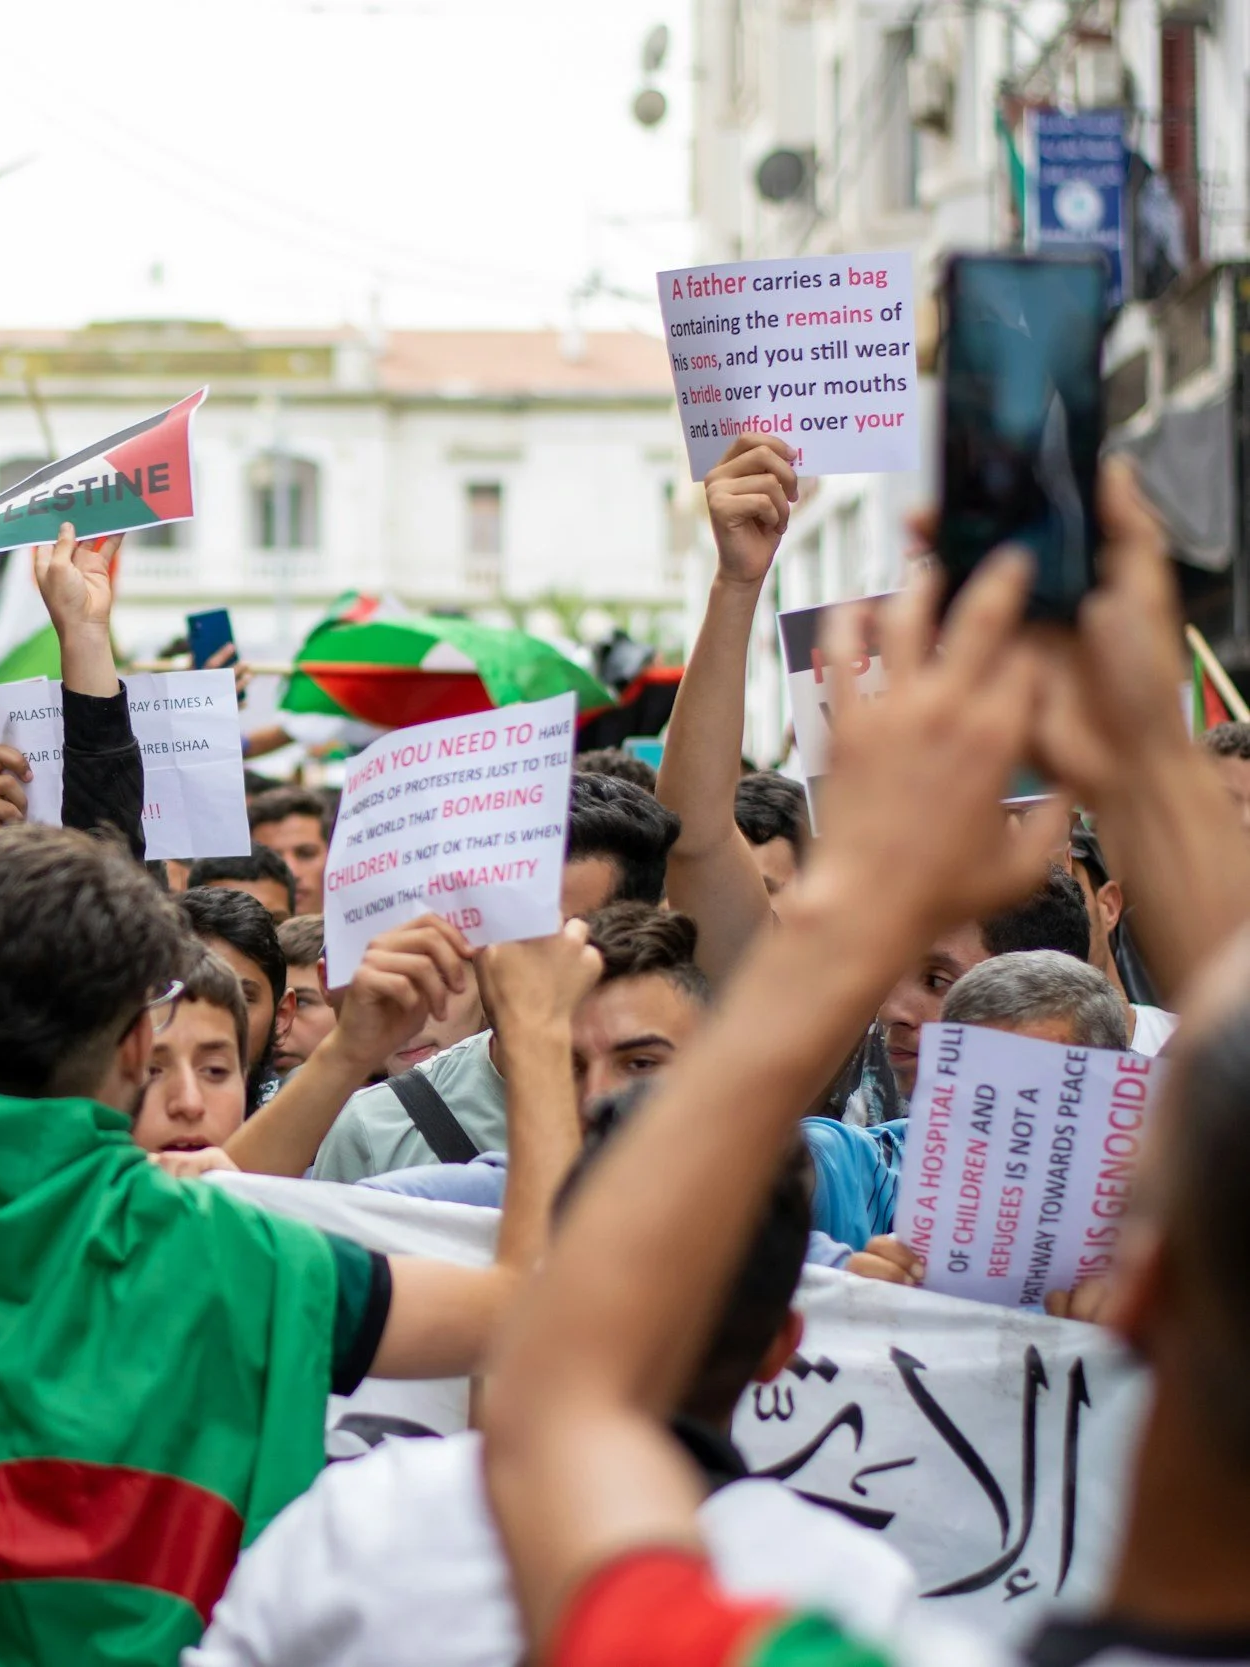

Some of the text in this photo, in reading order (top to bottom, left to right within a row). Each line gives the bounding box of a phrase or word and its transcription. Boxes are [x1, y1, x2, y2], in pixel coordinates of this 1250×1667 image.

[671, 266, 888, 301] A father carries a bag
[670, 302, 902, 338] containing the remains of
[672, 340, 910, 372] his sons, and you still wear
[681, 373, 907, 405] a bridle over your mouths
[690, 411, 905, 438] and a blindfold over your
[9, 696, 214, 723] PALASTIN RAY 6 TIMES A
[139, 742, 169, 755] HREB
[172, 739, 209, 753] ISHAA
[348, 720, 570, 795] WHEN YOU NEED TO HAVE
[387, 784, 401, 800] OF
[405, 768, 482, 795] PROTESTERS
[485, 762, 518, 778] JUST
[522, 757, 540, 771] TO
[543, 752, 568, 768] TELL
[346, 785, 544, 847] THE WORLD THAT BOMBING
[327, 824, 562, 891] CHILDREN IS NOT OK THAT IS WHEN
[343, 858, 539, 925] YOU KNOW THAT HUMANITY
[937, 1027, 963, 1076] FULL
[920, 1084, 956, 1190] HOSPITAL
[1091, 1056, 1151, 1219] GENOCIDE
[948, 1083, 996, 1273] OF CHILDREN AND
[987, 1087, 1040, 1278] REFUGEES IS NOT A
[1019, 1049, 1088, 1304] PATHWAY TOWARDS PEACE
[917, 1193, 937, 1211] A
[1083, 1226, 1121, 1246] IS
